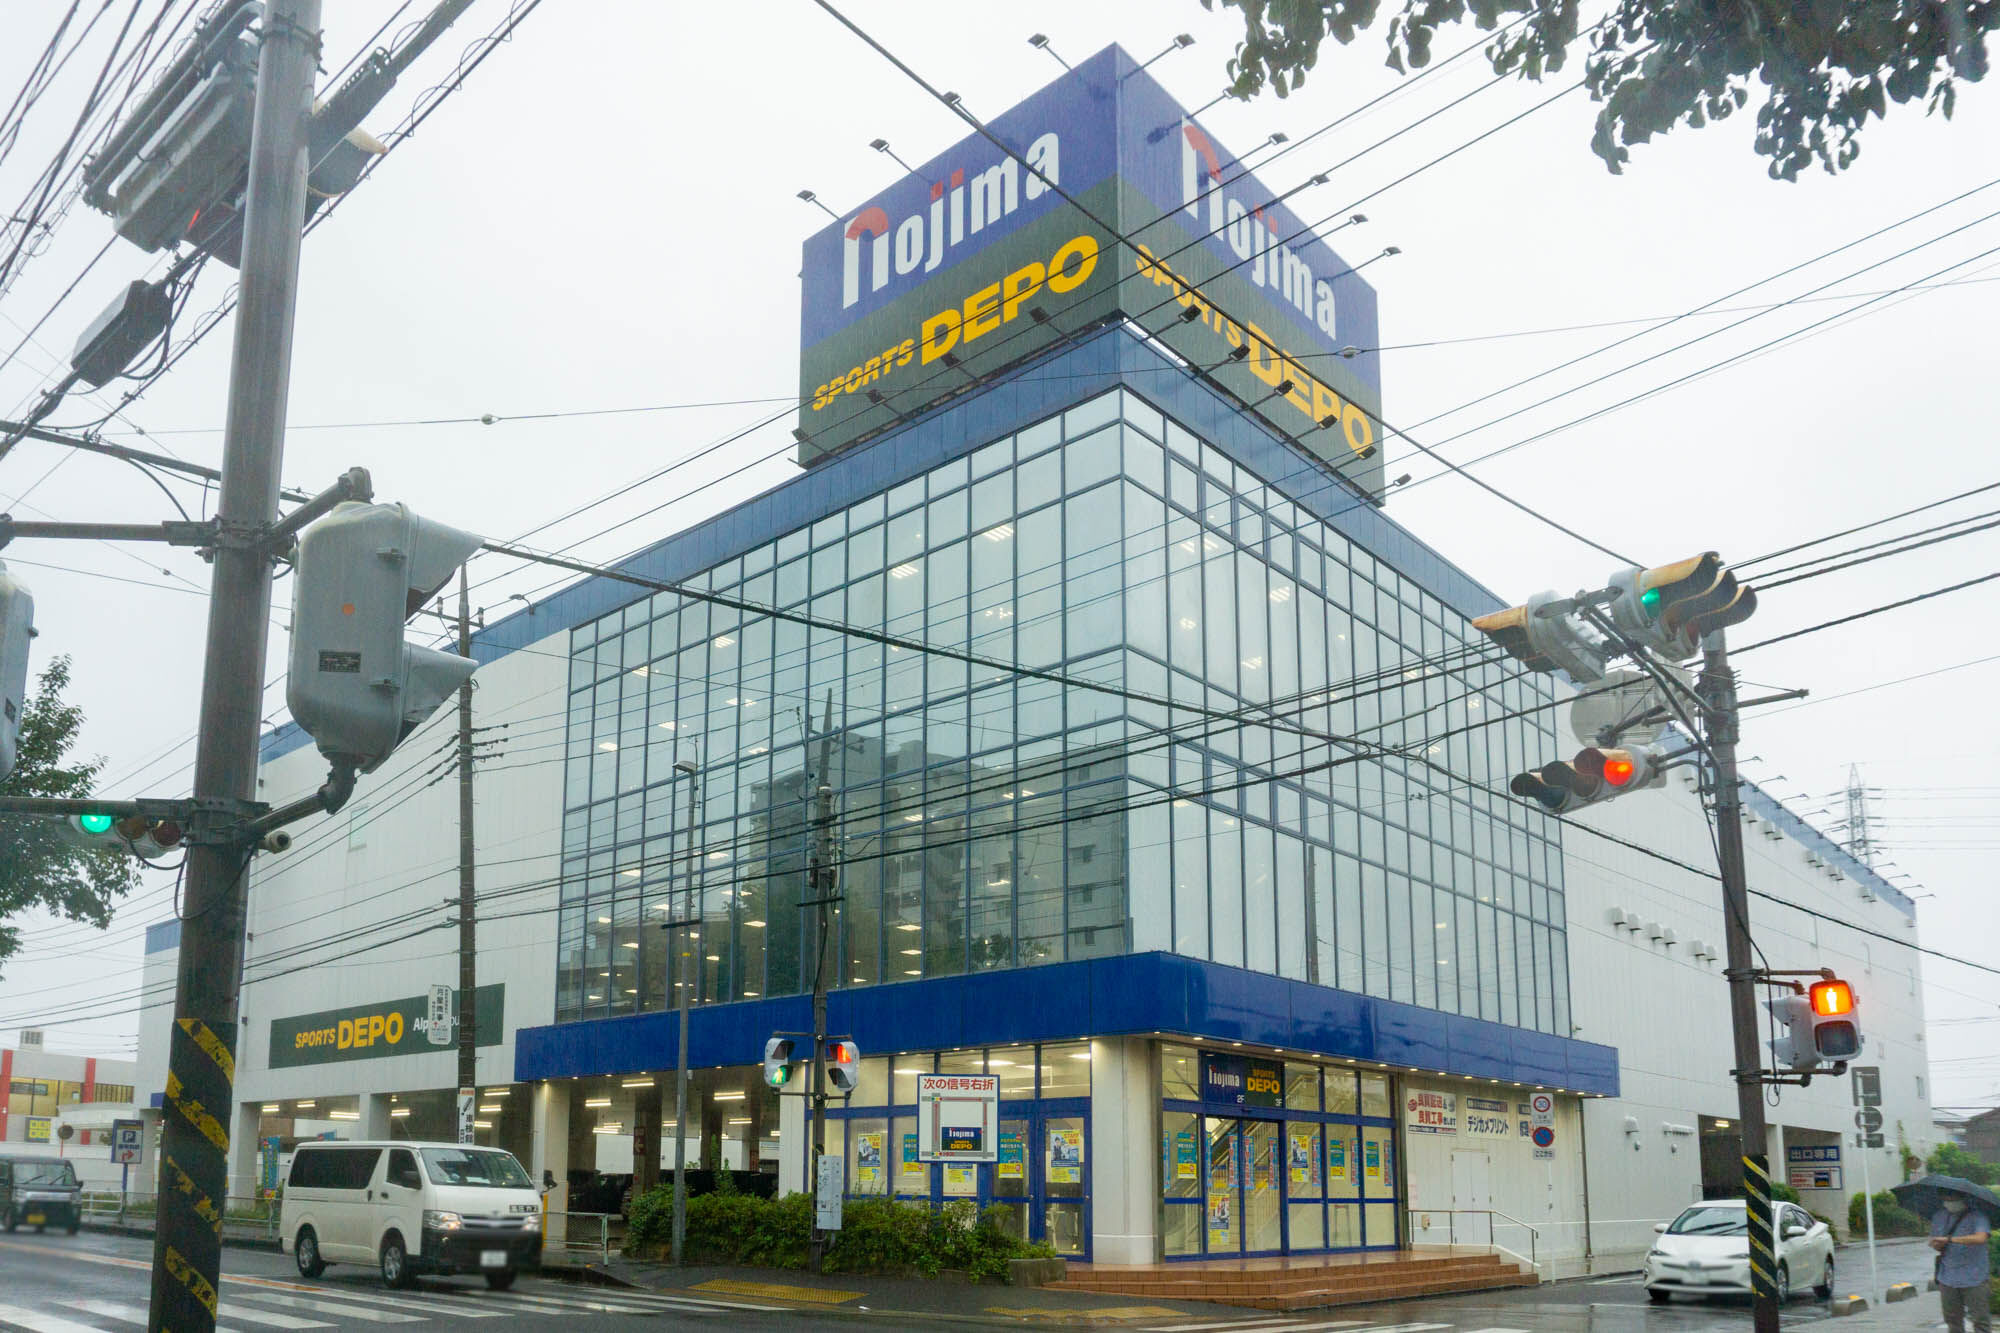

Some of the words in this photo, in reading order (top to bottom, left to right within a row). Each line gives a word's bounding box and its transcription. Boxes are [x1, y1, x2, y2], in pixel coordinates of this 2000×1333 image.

[843, 132, 1060, 310] nojima
[1182, 115, 1336, 341] nojima
[812, 338, 914, 411] SPORTS
[921, 235, 1099, 365] DEPO
[1136, 244, 1242, 348] SPORTS
[1248, 319, 1373, 457] DEPO
[295, 1028, 336, 1048] SPORTS
[337, 1012, 404, 1050] DEPO
[923, 1077, 994, 1091] 次の信号右折
[1209, 1064, 1240, 1088] nojima
[1248, 1077, 1280, 1094] DEPO
[1467, 1115, 1510, 1135] デジカメプリント
